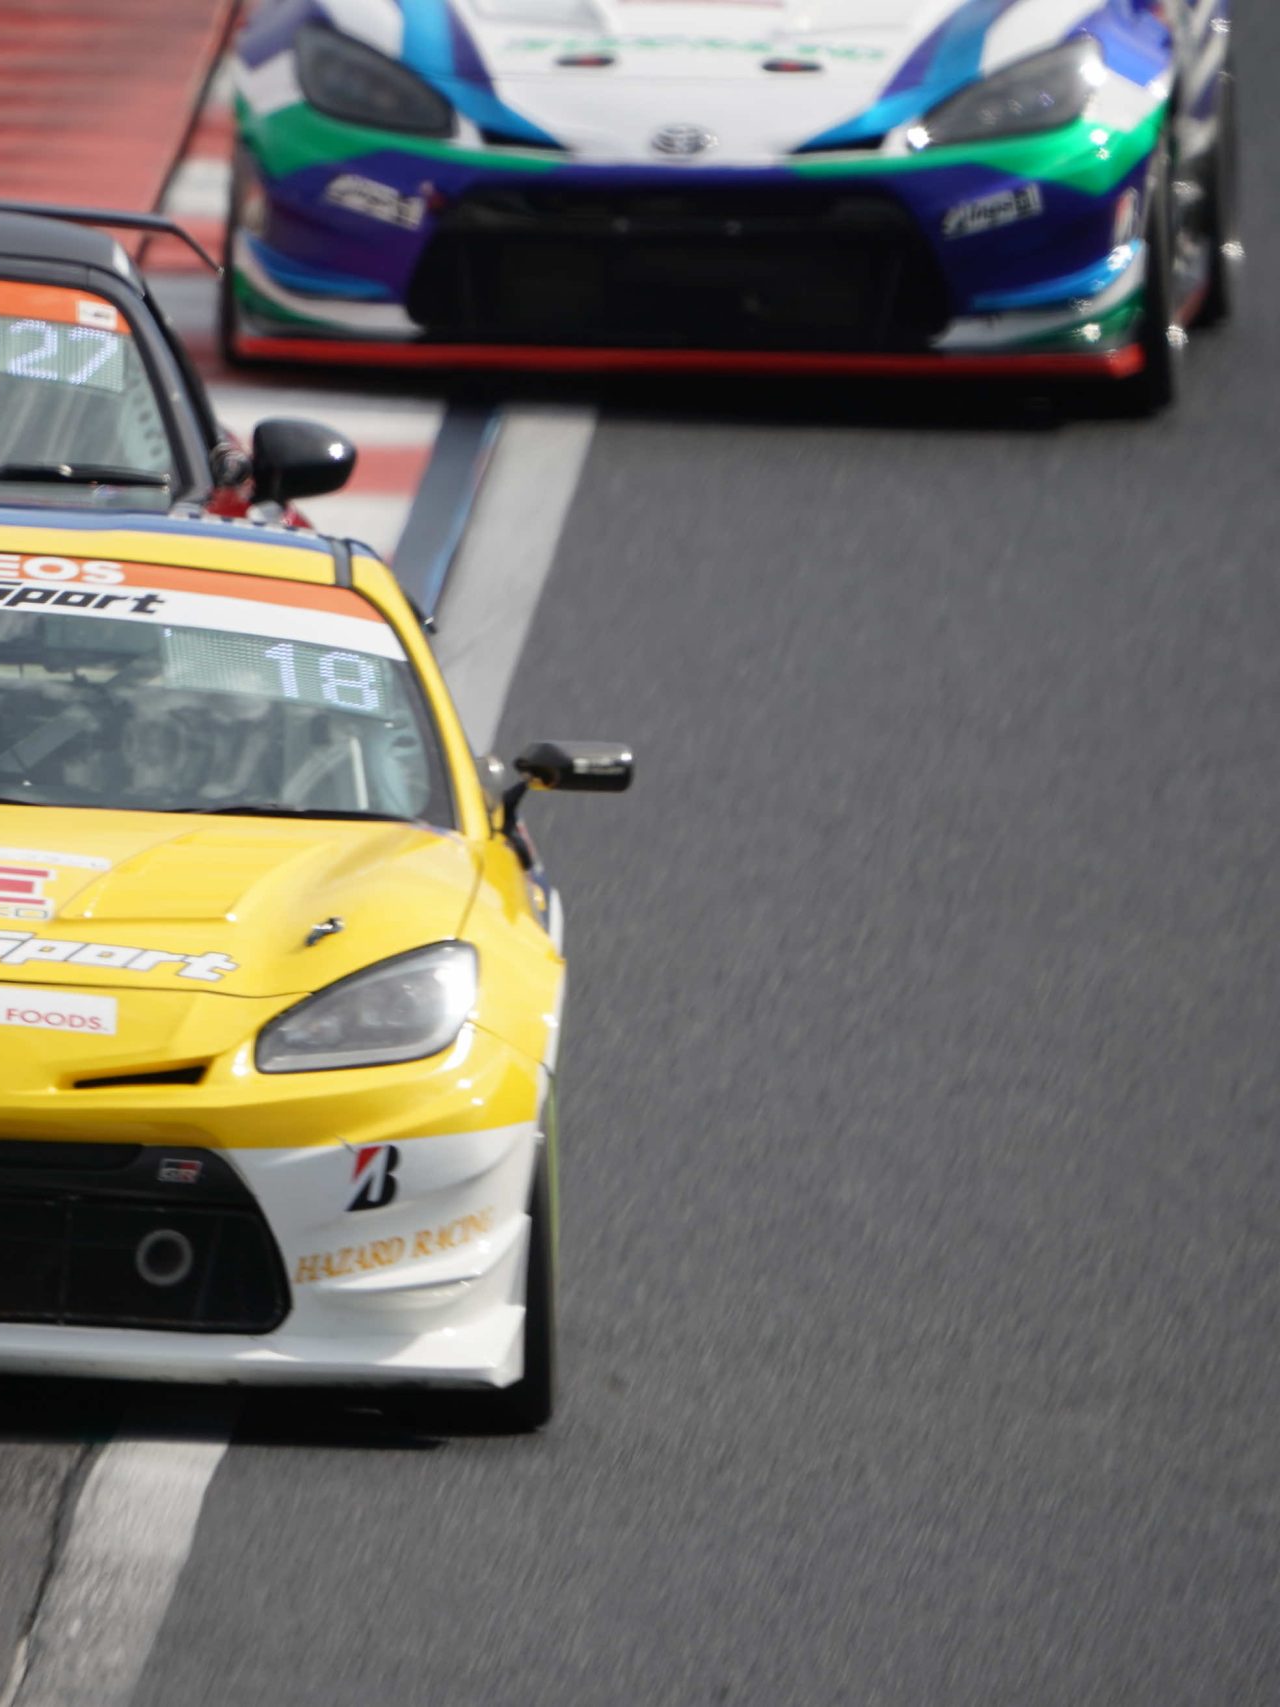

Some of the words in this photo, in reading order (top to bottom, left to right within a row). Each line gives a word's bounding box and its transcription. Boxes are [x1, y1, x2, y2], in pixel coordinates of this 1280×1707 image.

[8, 318, 118, 385] 27
[265, 643, 380, 710] 18
[294, 1236, 406, 1284] HAZARD
